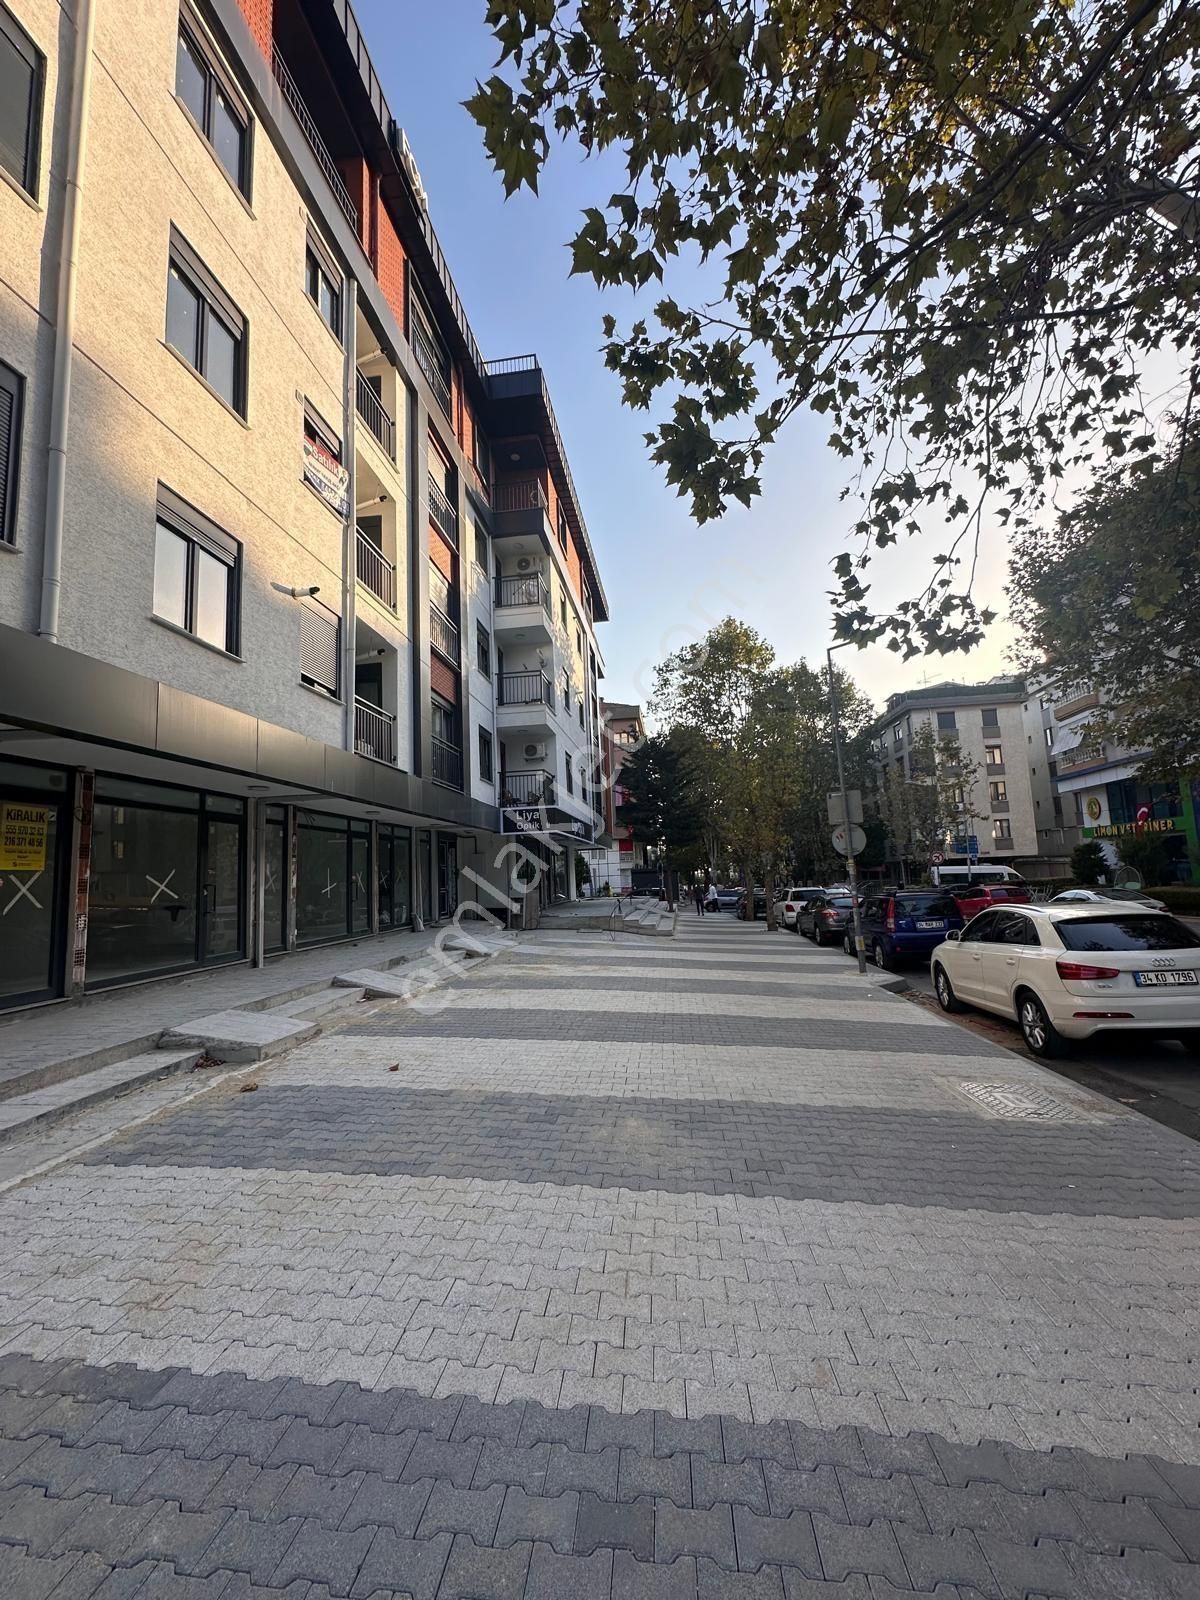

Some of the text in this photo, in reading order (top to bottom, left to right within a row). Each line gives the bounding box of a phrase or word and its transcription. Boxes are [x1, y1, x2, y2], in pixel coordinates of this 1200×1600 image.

[516, 810, 540, 822] Liya
[516, 821, 540, 832] Optik
[1141, 973, 1153, 983] 34
[1171, 972, 1194, 982] 1796
